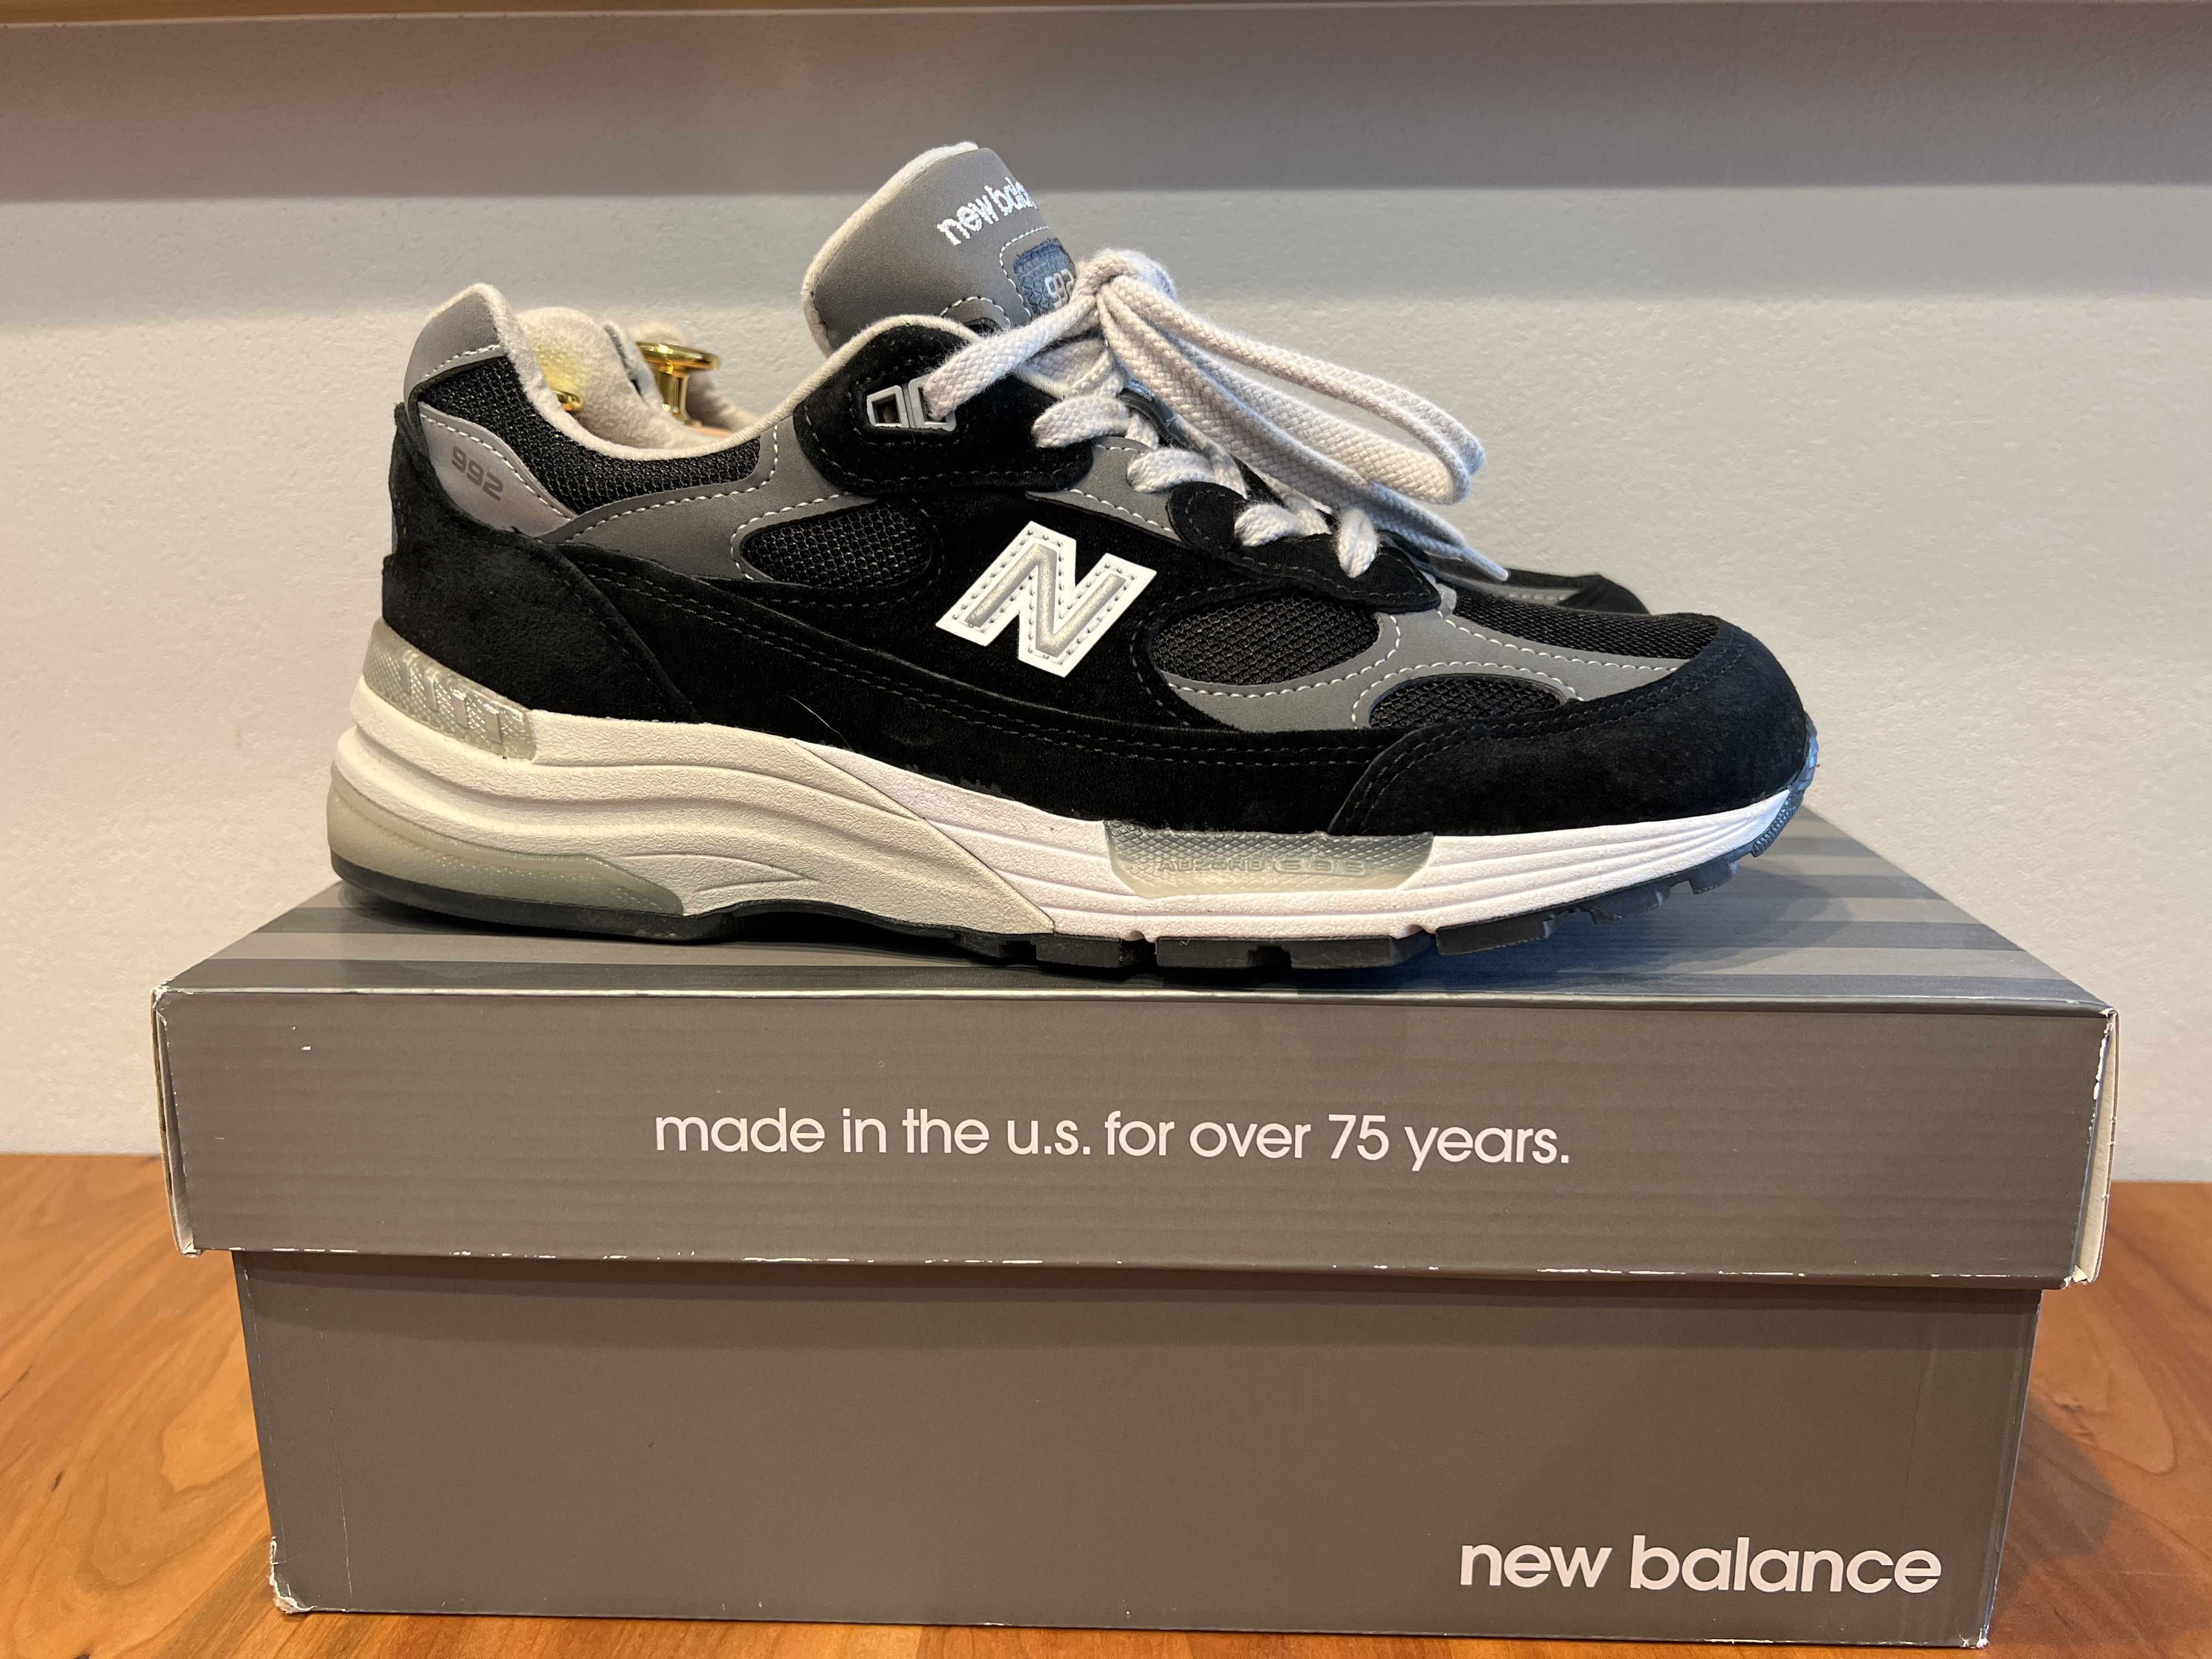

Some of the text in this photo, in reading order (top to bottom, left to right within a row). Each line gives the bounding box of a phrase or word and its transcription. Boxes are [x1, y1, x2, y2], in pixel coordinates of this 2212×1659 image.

[936, 195, 1000, 246] new
[452, 446, 504, 501] 992
[935, 520, 1157, 678] N
[656, 1107, 1569, 1171] made in the u.s. for over 75 years.
[1460, 1534, 1942, 1593] new balance
